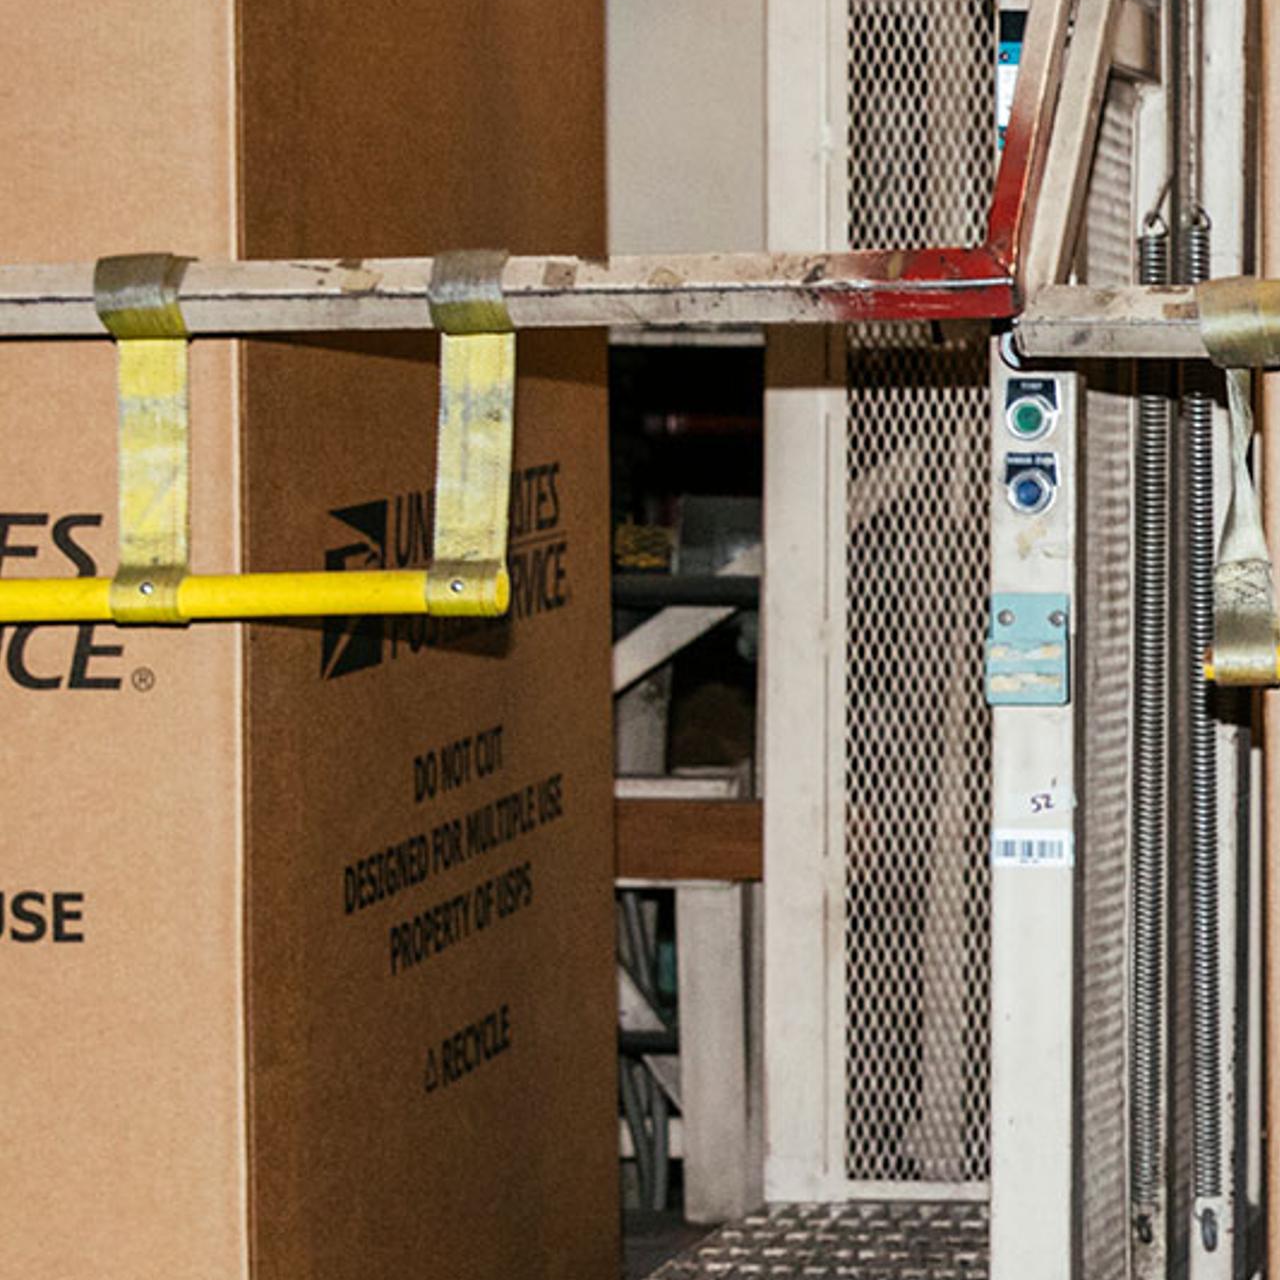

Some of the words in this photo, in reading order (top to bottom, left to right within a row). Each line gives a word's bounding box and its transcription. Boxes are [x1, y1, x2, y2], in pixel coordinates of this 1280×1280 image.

[413, 751, 438, 804] DO
[440, 734, 472, 792] NOT
[474, 724, 504, 778] CUT
[344, 832, 428, 916] DESIGNED
[431, 819, 464, 874] FOR
[465, 784, 535, 855] MULTIPLE
[537, 772, 564, 826] USE
[0, 891, 84, 943] SE
[388, 893, 472, 977] PROPERTY
[473, 876, 495, 932] OF
[496, 860, 534, 921] USPS
[441, 1002, 511, 1086] RECYCLE
